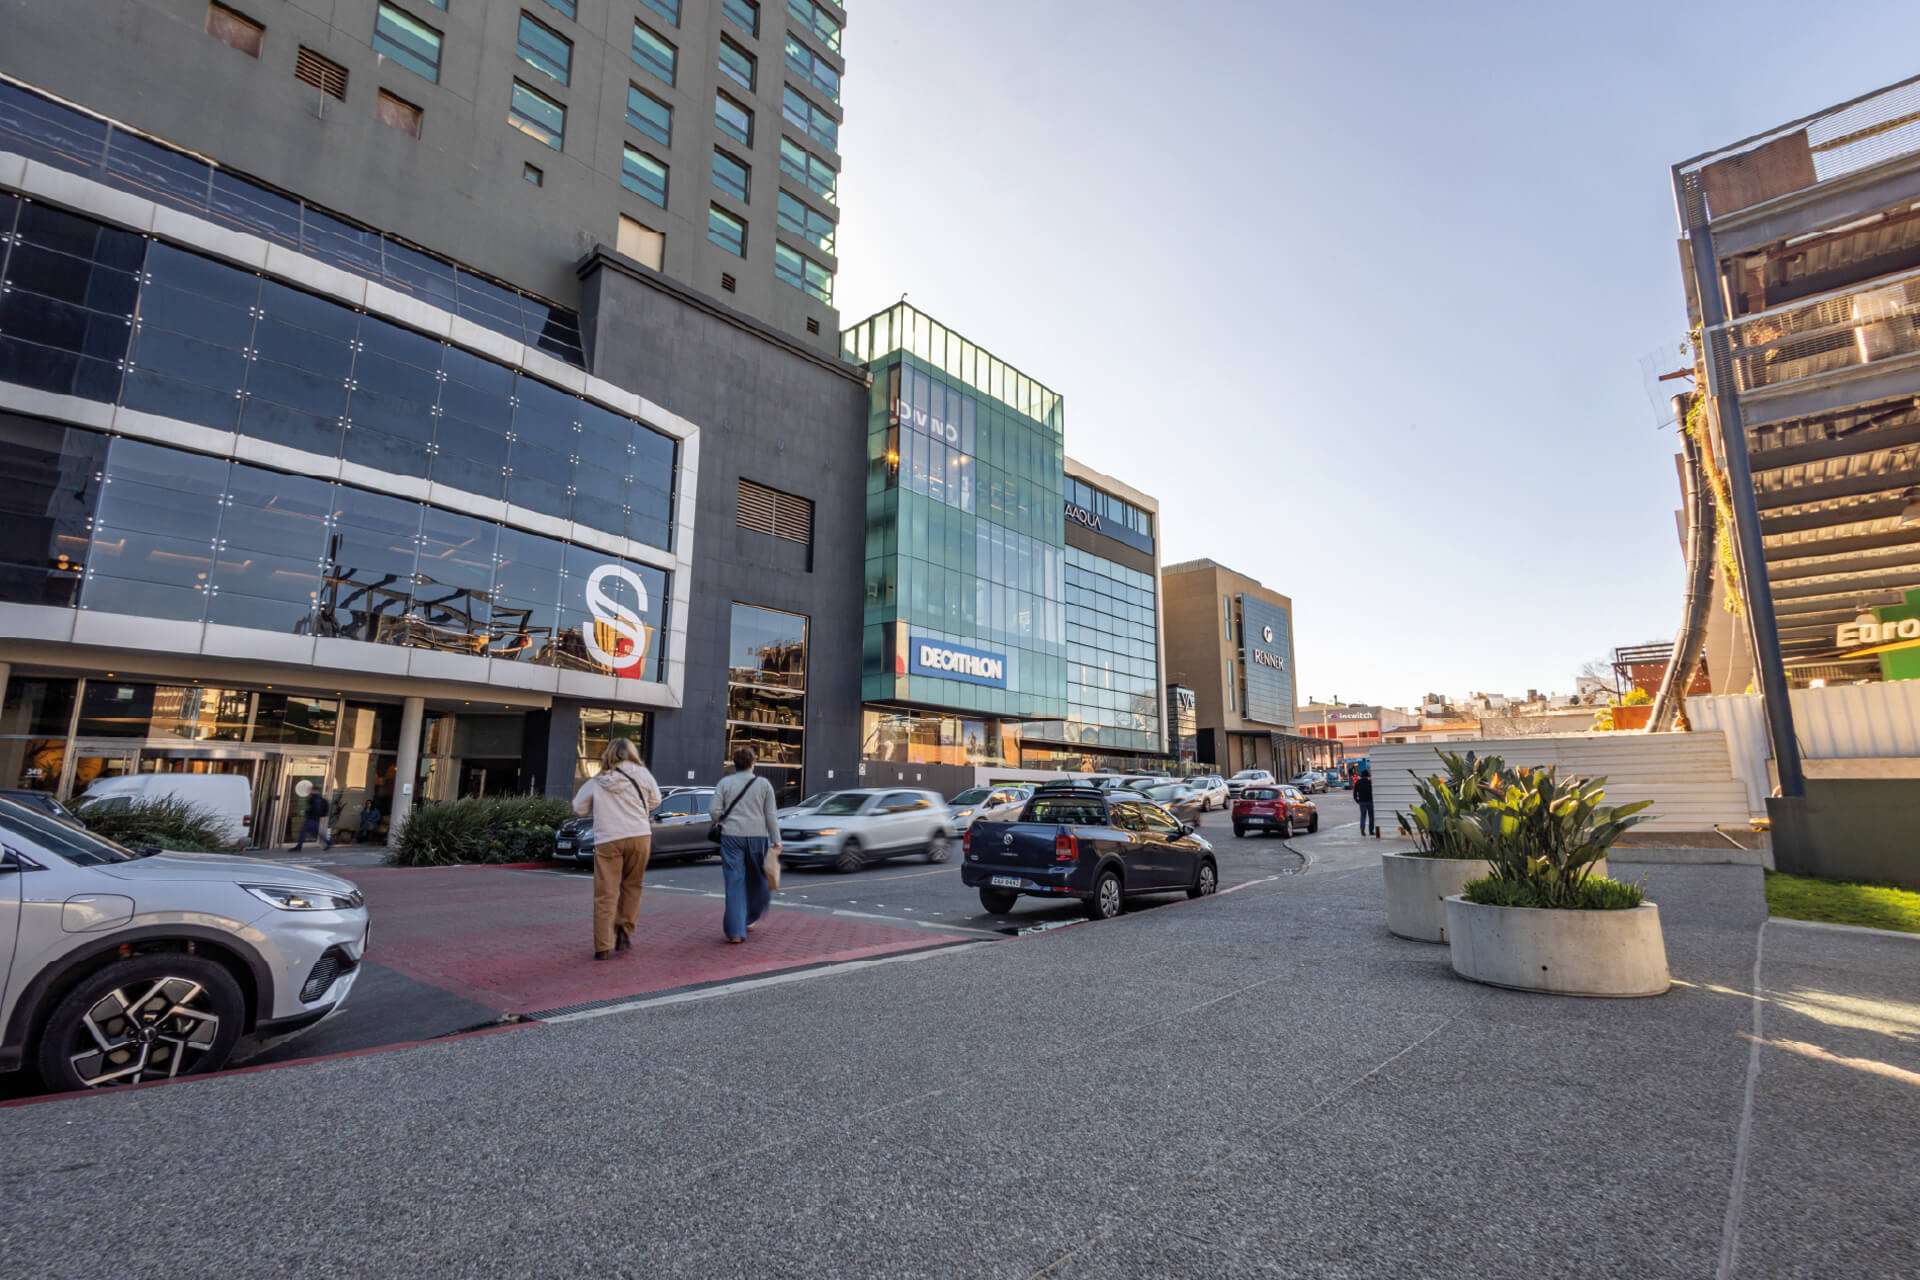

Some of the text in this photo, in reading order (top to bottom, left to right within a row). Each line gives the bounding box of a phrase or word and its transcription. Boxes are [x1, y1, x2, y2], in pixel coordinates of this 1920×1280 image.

[583, 564, 648, 669] S
[920, 645, 1002, 680] DECATHLON
[1254, 648, 1284, 670] RENNER
